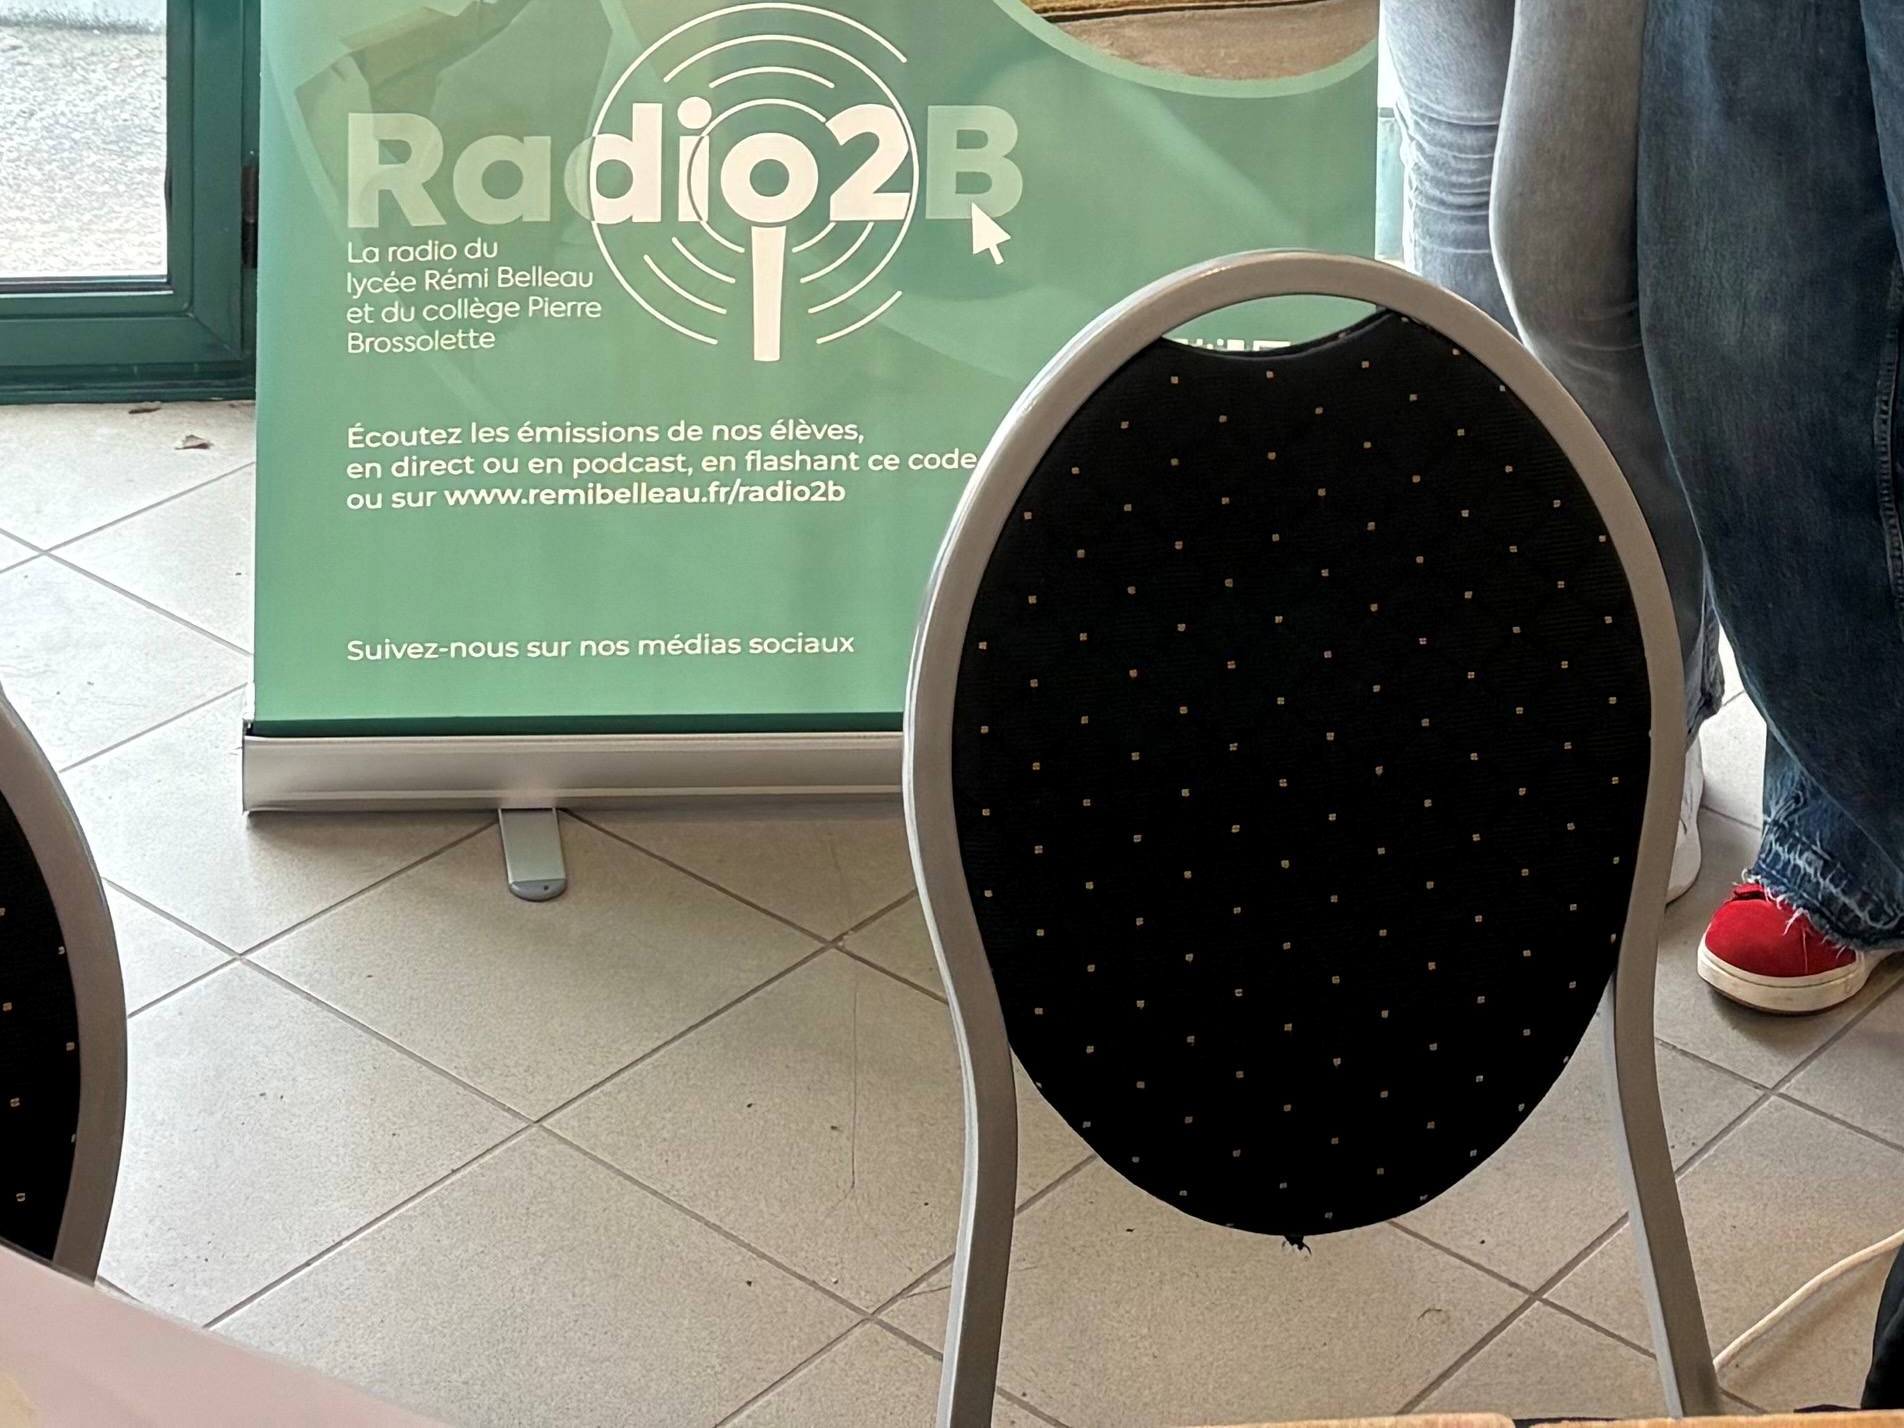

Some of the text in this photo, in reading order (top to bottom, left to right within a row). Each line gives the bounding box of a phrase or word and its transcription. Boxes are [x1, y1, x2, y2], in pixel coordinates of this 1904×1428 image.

[346, 94, 1024, 230] Radio2B
[347, 236, 498, 264] La radio du
[347, 265, 593, 299] lycée Rémi Belleau
[346, 295, 602, 324] et du collège Pierre
[347, 328, 496, 354] Brossolette
[348, 418, 865, 449] Écoutez les émissions de nos élèves,
[346, 447, 978, 480] en direct ou en podcast, en flashant ce code
[346, 479, 846, 510] ou sur www.remibelleau.fr/radio2b
[347, 631, 855, 661] Suivez-nous sur nos médias sociaux
